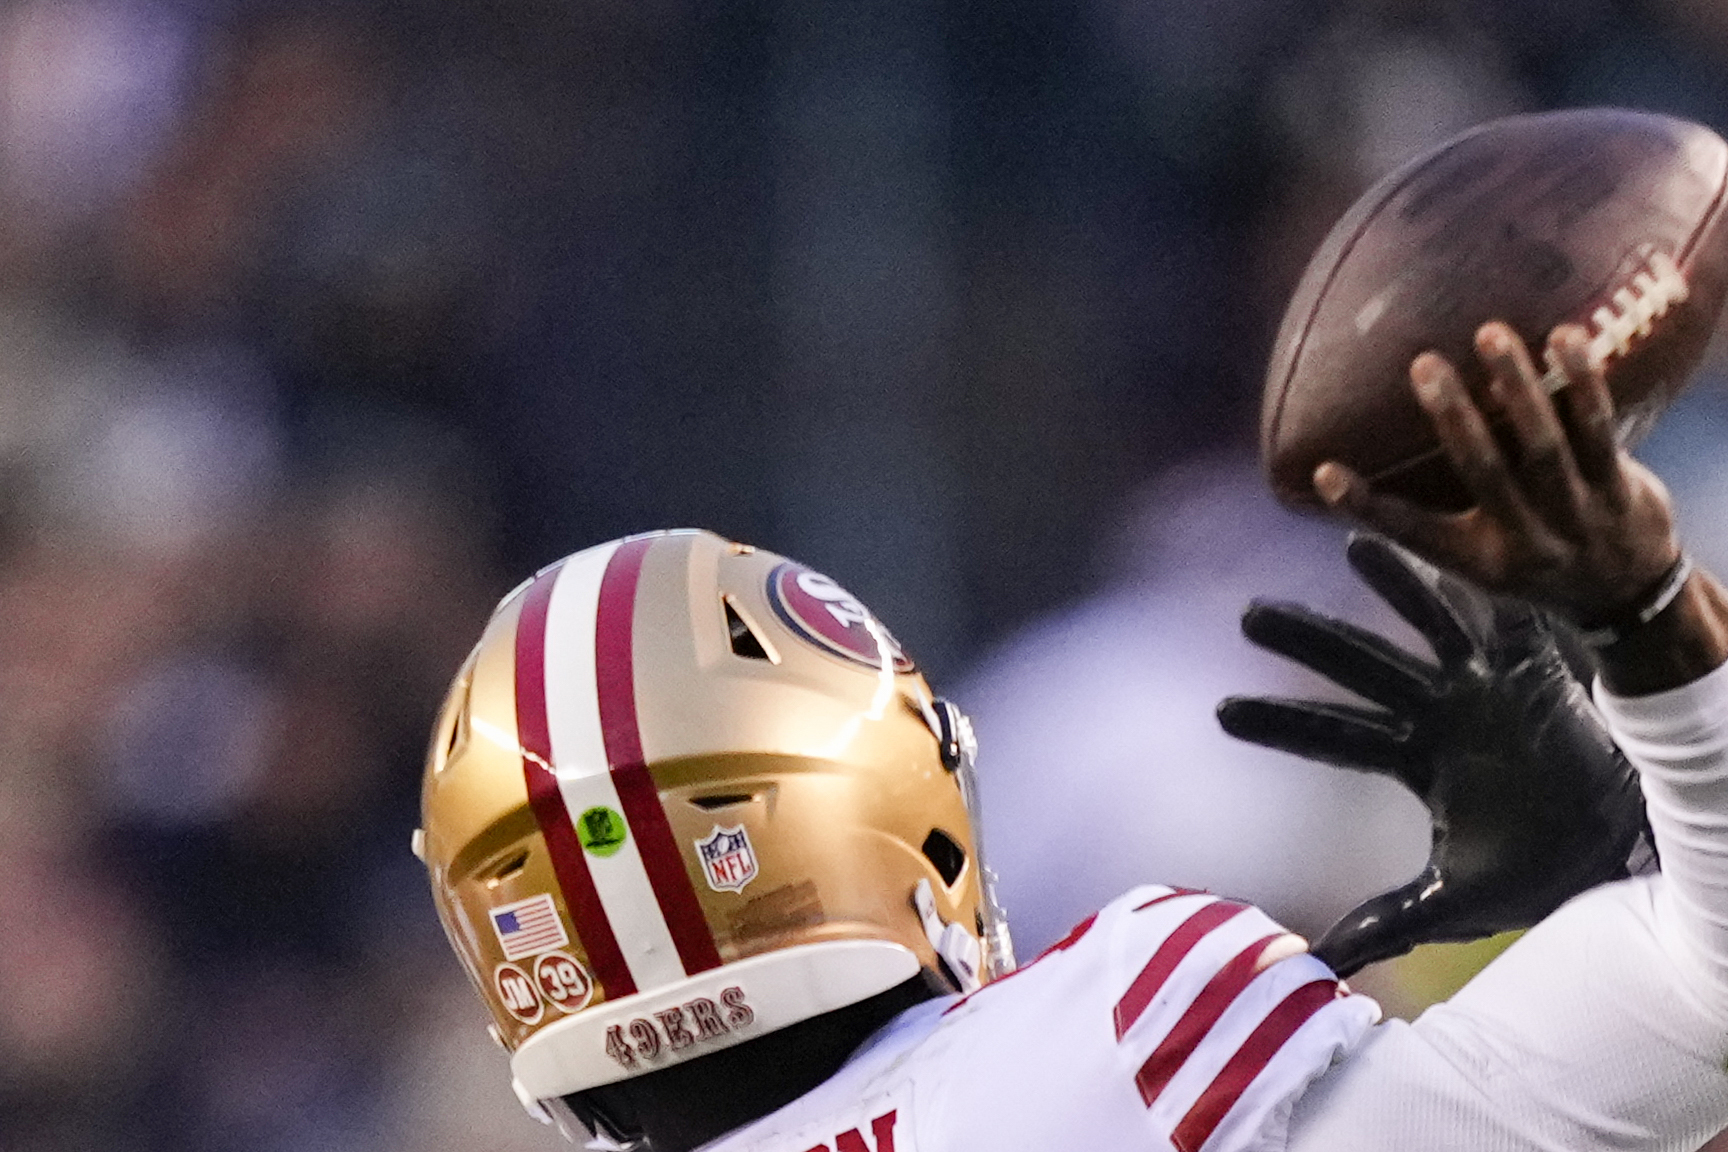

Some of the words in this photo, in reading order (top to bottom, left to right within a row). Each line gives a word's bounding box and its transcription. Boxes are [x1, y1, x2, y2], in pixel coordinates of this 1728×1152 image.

[711, 852, 752, 884] NFL
[539, 961, 588, 1001] 39
[605, 985, 755, 1070] 49ERS
